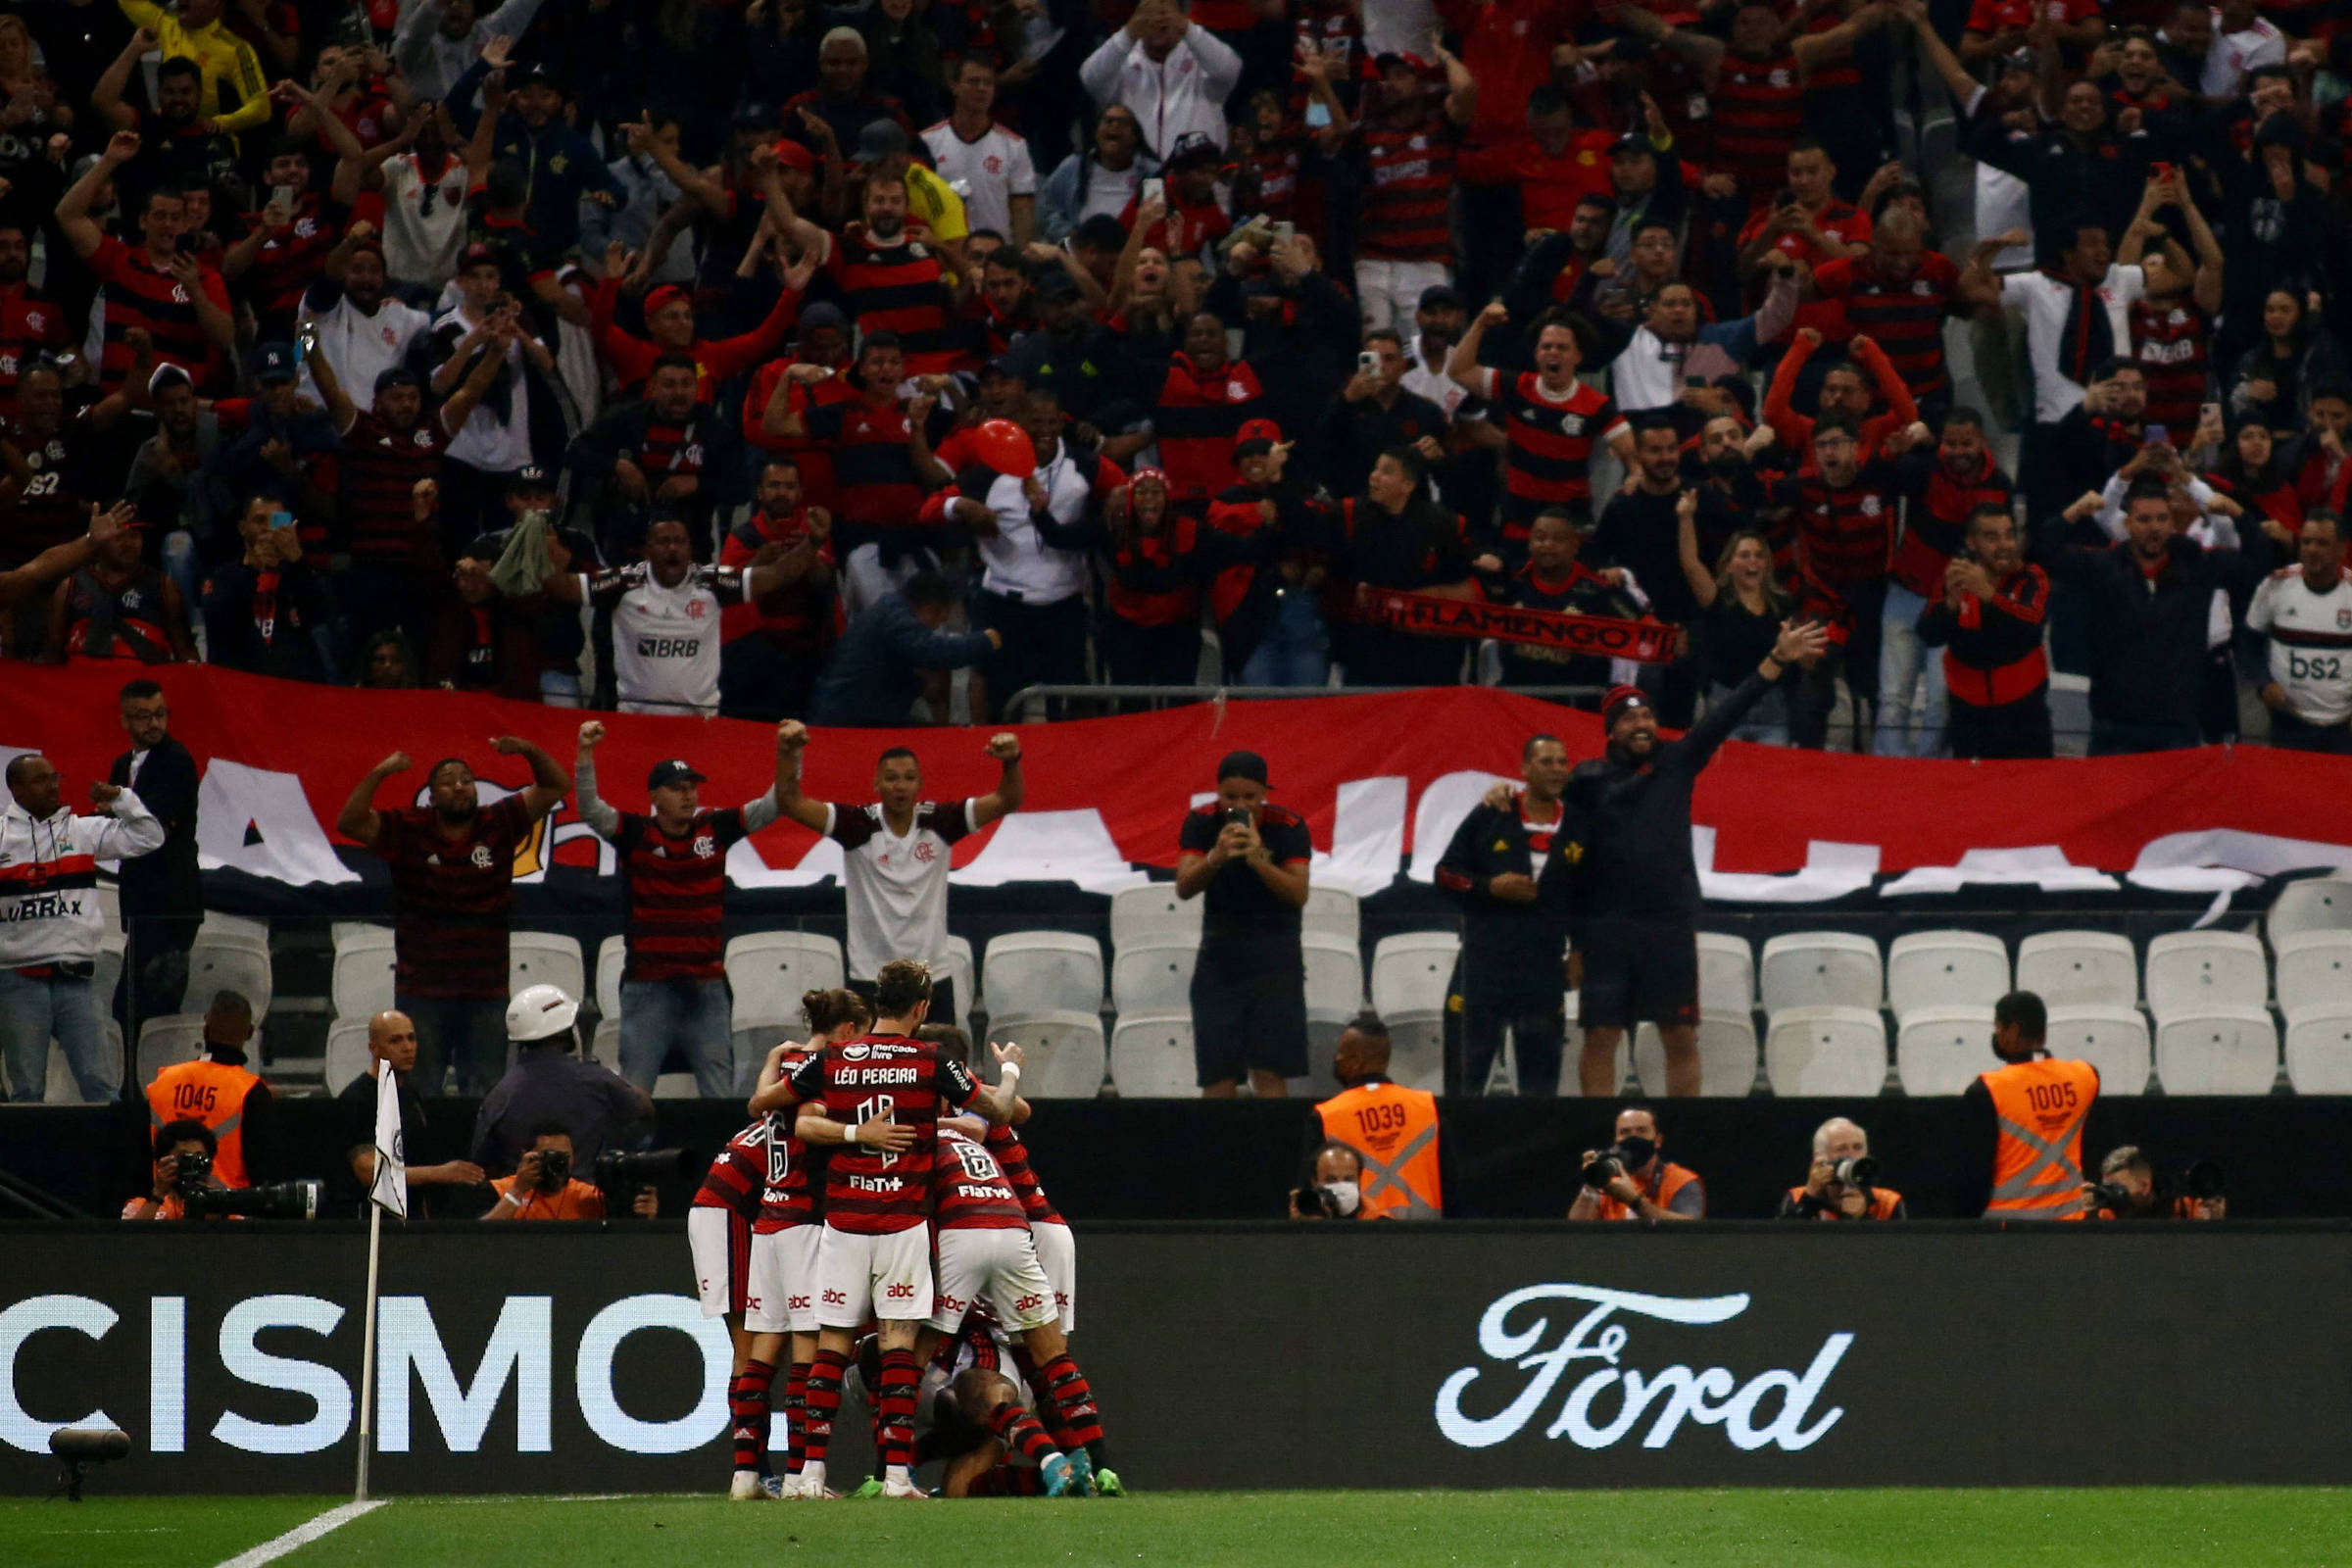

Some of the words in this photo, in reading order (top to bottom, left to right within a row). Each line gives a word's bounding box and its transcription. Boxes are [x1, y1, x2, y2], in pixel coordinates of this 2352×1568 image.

[1412, 602, 1631, 649] FLAMENGO
[657, 639, 699, 658] BRB
[2289, 650, 2341, 679] bs2
[871, 1051, 893, 1060] livre
[872, 1044, 917, 1054] mercado
[834, 1066, 858, 1085] LÉO
[861, 1067, 917, 1085] PEREIRA
[946, 1059, 971, 1092] HAVAN
[173, 1084, 218, 1112] 1045
[2025, 1082, 2078, 1112] 1005
[1354, 1103, 1405, 1134] 1039
[951, 1142, 1000, 1181] 8
[821, 1288, 847, 1304] abc
[887, 1282, 914, 1298] abc
[788, 1295, 810, 1309] abc
[936, 1294, 966, 1312] abc
[1015, 1293, 1042, 1311] abc
[1434, 1282, 1856, 1451] Ford
